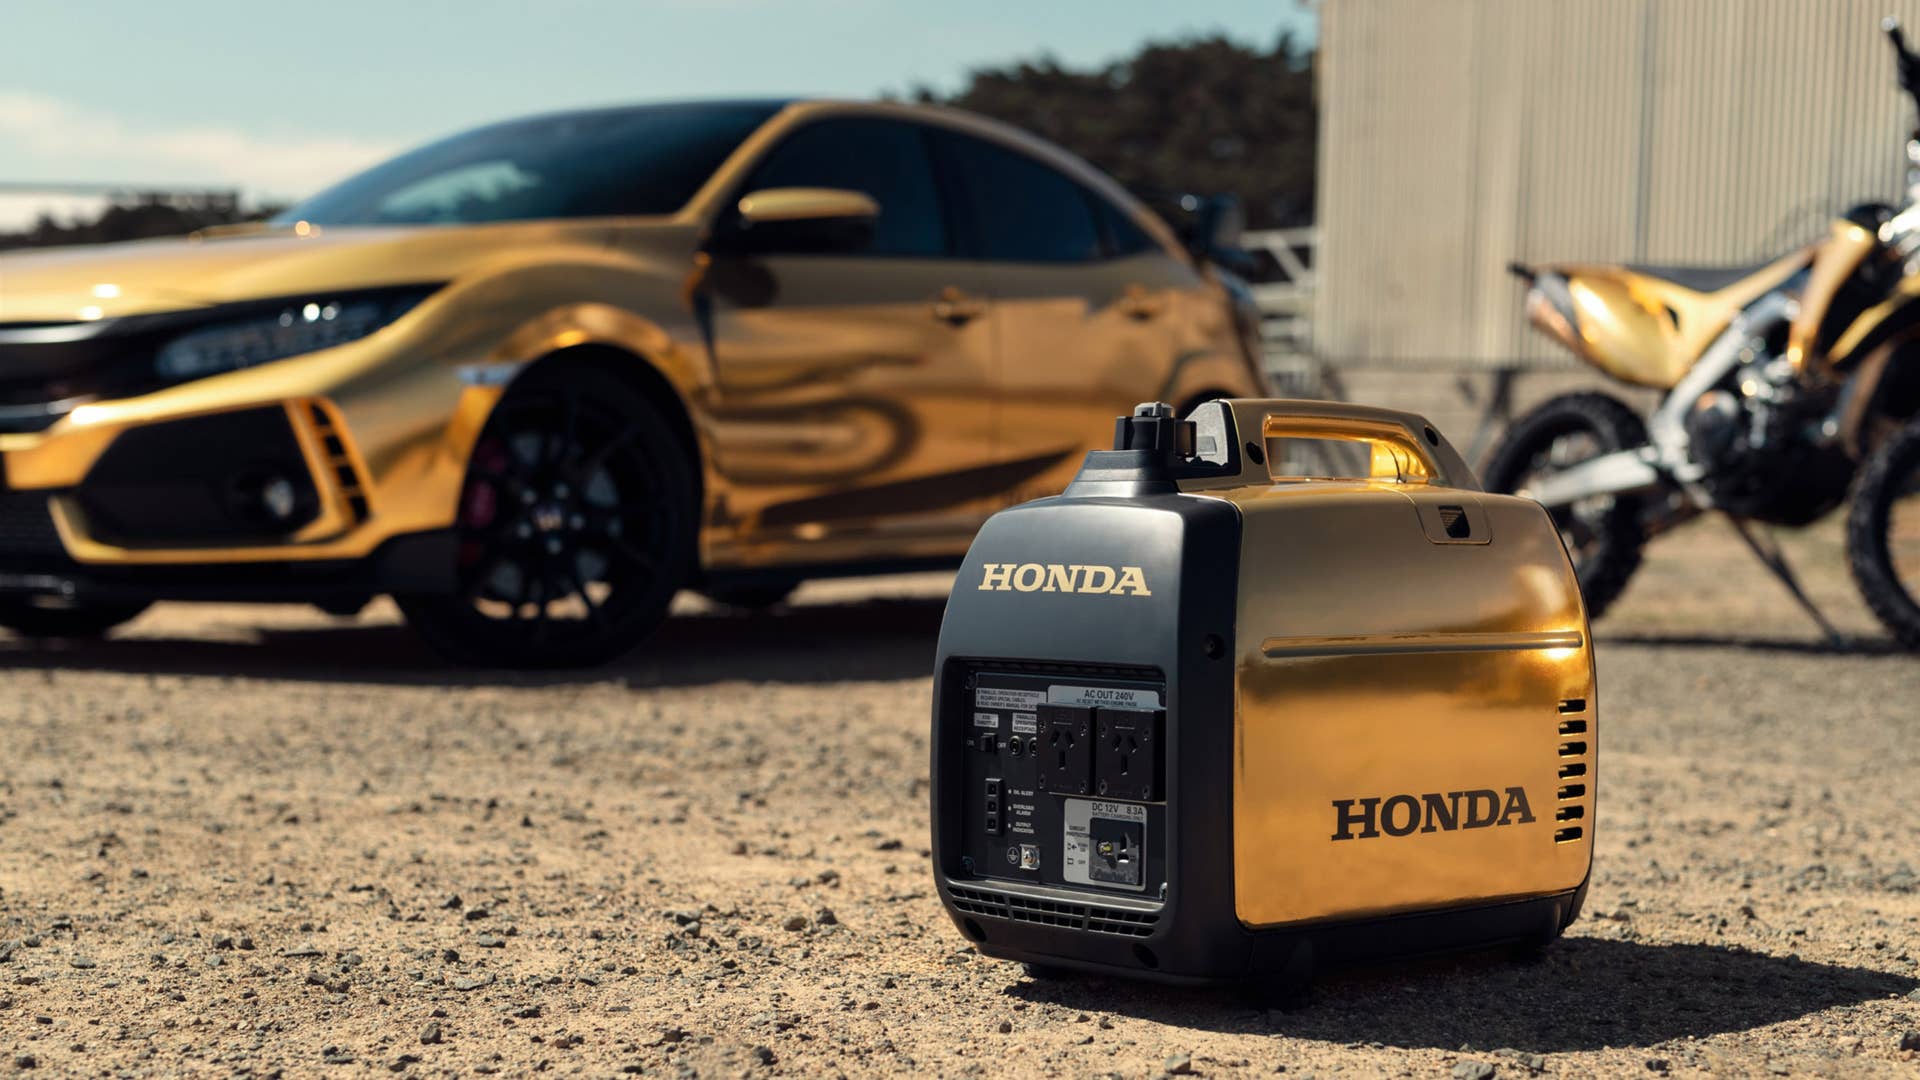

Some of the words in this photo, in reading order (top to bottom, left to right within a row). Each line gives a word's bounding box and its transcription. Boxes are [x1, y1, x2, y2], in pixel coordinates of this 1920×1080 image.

[978, 563, 1152, 596] HONDA
[1084, 689, 1096, 698] AC
[1097, 690, 1114, 699] OUT
[1115, 691, 1135, 700] 240V
[1092, 803, 1103, 812] DC
[1105, 804, 1119, 813] 12V
[1126, 806, 1144, 815] 8.3A
[1331, 786, 1536, 841] HONDA
